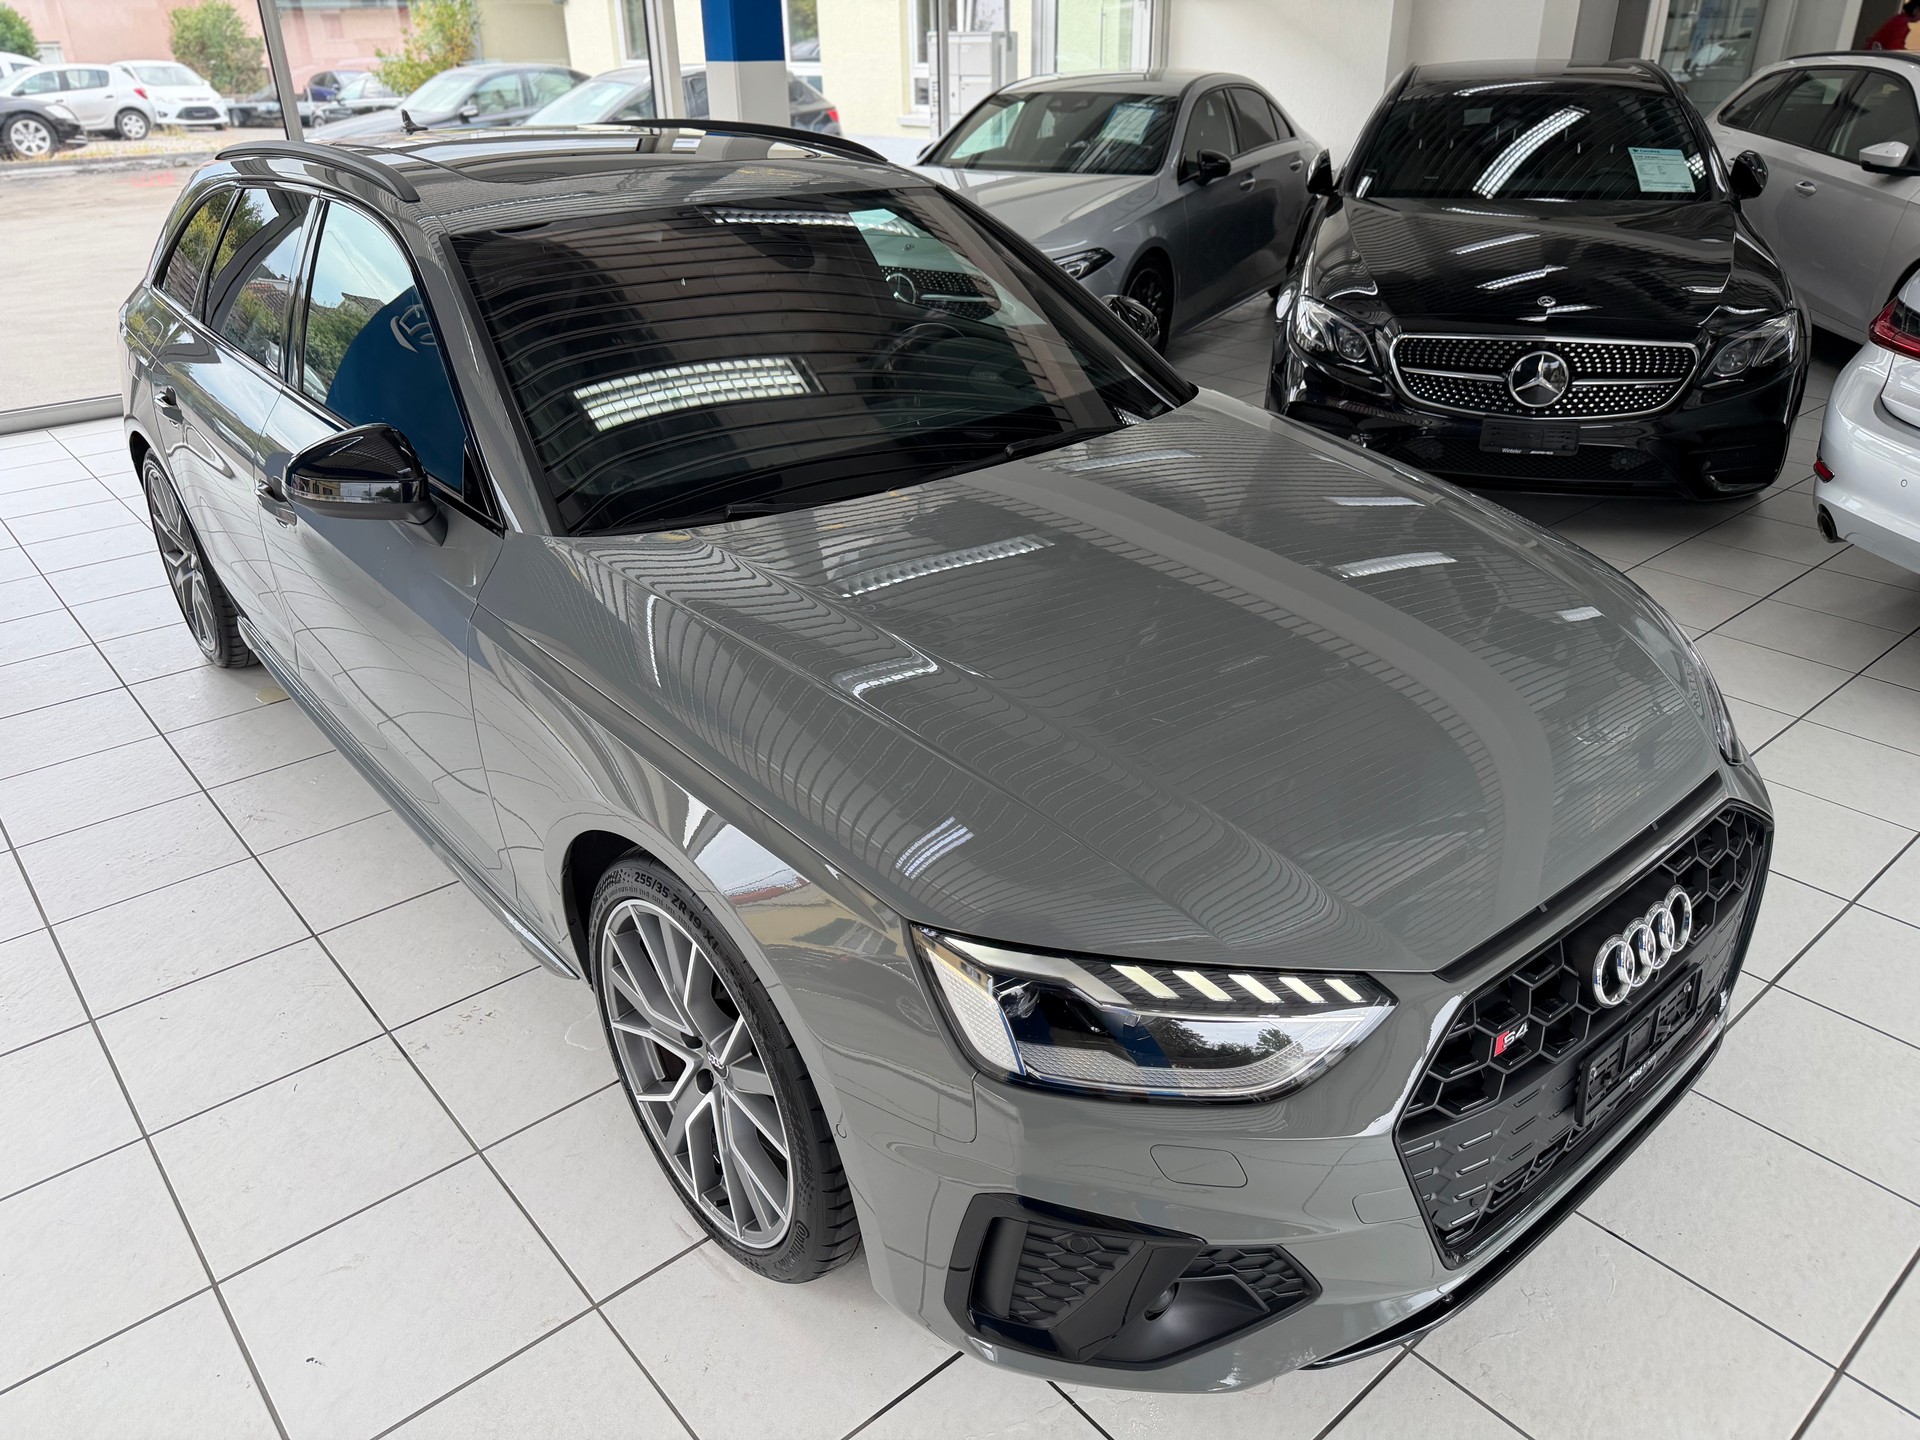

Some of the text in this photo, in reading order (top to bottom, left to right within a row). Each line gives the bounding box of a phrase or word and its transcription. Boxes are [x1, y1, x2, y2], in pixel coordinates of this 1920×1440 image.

[634, 872, 670, 898] 255/35
[703, 928, 720, 956] XL
[1503, 1022, 1528, 1049] S4
